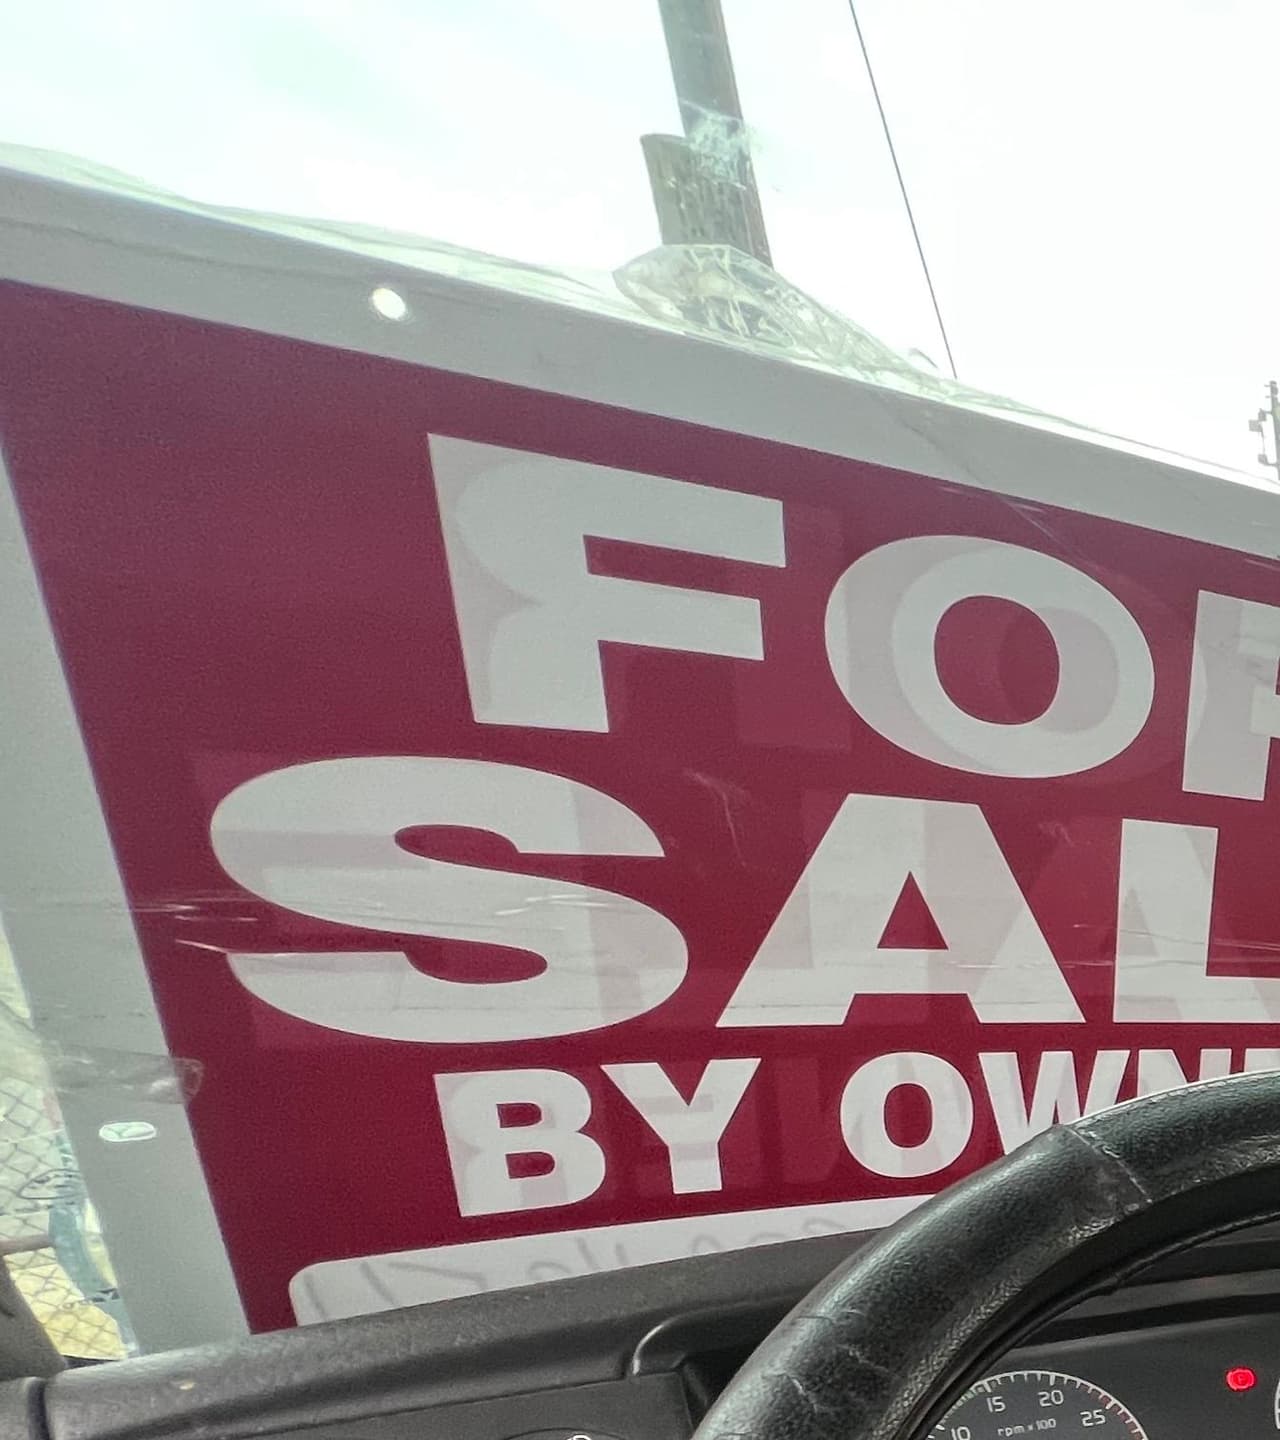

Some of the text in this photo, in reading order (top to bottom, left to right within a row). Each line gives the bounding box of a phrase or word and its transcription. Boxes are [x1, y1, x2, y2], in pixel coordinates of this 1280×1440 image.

[436, 1057, 761, 1217] BY
[987, 1396, 1006, 1412] 15
[1038, 1391, 1064, 1407] 20
[1080, 1409, 1106, 1427] 25
[998, 1425, 1025, 1437] rpm
[1036, 1418, 1056, 1430] 100
